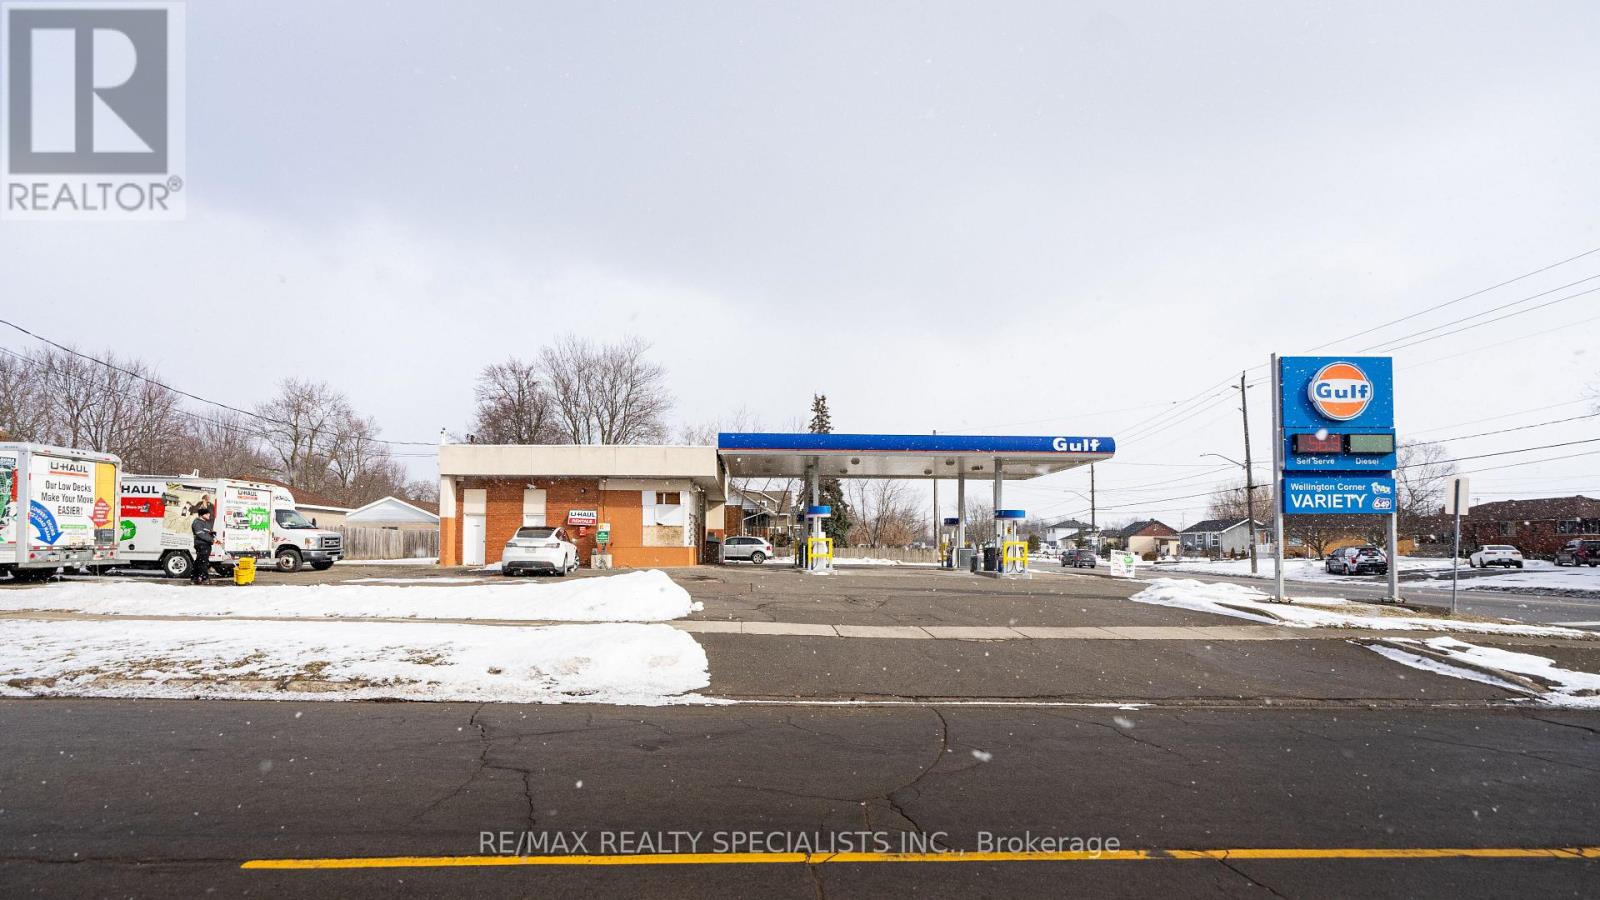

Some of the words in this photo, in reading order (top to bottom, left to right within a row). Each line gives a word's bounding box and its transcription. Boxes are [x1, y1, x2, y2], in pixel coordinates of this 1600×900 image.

[1316, 383, 1368, 398] Gulf
[1053, 437, 1101, 451] Gulf
[50, 461, 89, 473] U-HAUL
[1296, 457, 1311, 465] Self
[1313, 457, 1335, 465] Serve
[1355, 457, 1379, 465] Diesel
[45, 480, 57, 490] Our
[58, 482, 71, 491] Low
[72, 482, 92, 493] Decks
[121, 485, 159, 494] HAUL
[1290, 483, 1335, 492] Wellington
[1337, 483, 1366, 491] Corner
[41, 492, 60, 502] Make
[61, 493, 76, 503] Your
[77, 494, 94, 504] Move
[1291, 493, 1368, 508] VARIETY
[57, 505, 84, 516] EASIER!
